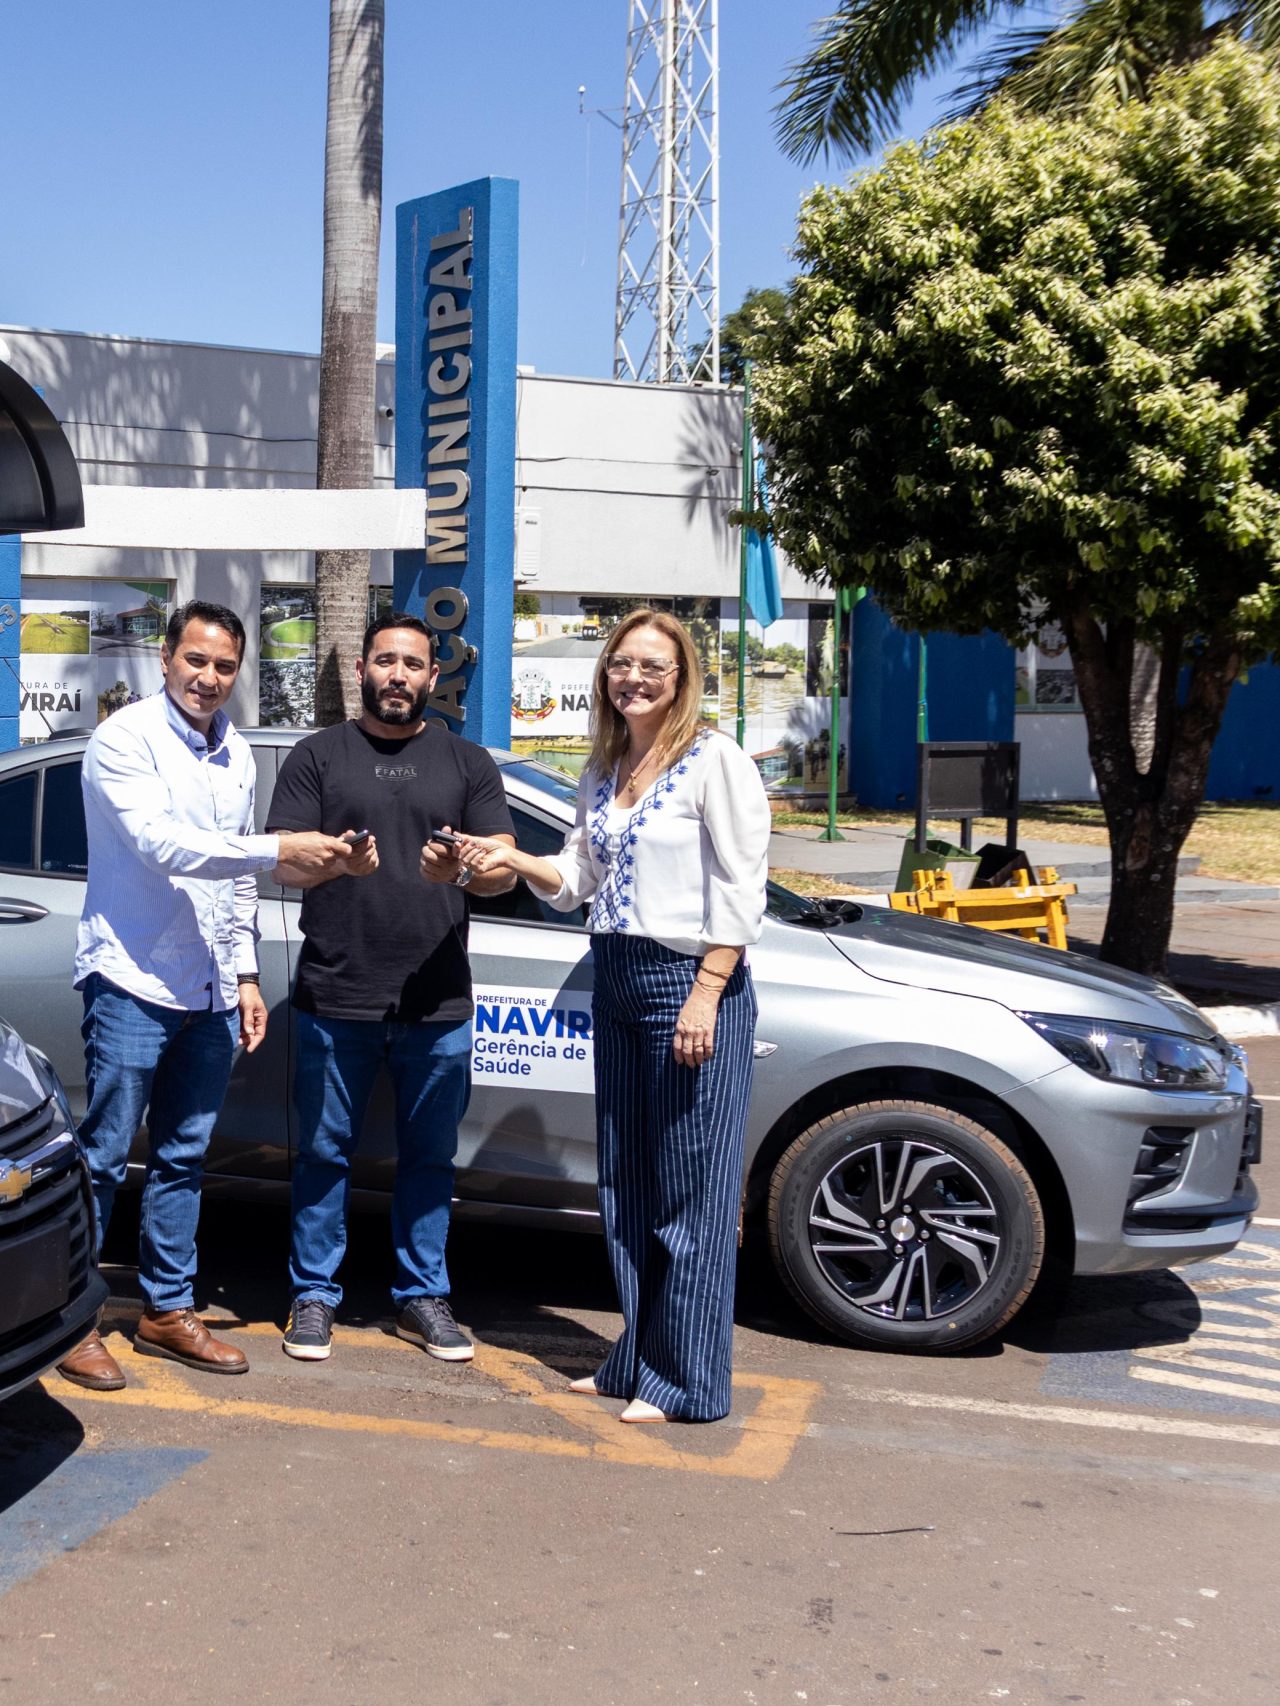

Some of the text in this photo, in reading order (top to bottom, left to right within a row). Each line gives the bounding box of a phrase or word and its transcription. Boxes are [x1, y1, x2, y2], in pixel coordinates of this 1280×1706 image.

[426, 207, 474, 564] MUNICIPAL
[55, 682, 68, 690] DE
[561, 694, 592, 711] NA
[476, 995, 547, 1007] PREFEITURA DE
[476, 1004, 594, 1040] NAVIR
[474, 1038, 587, 1060] Gerência de
[473, 1056, 531, 1075] Saúde
